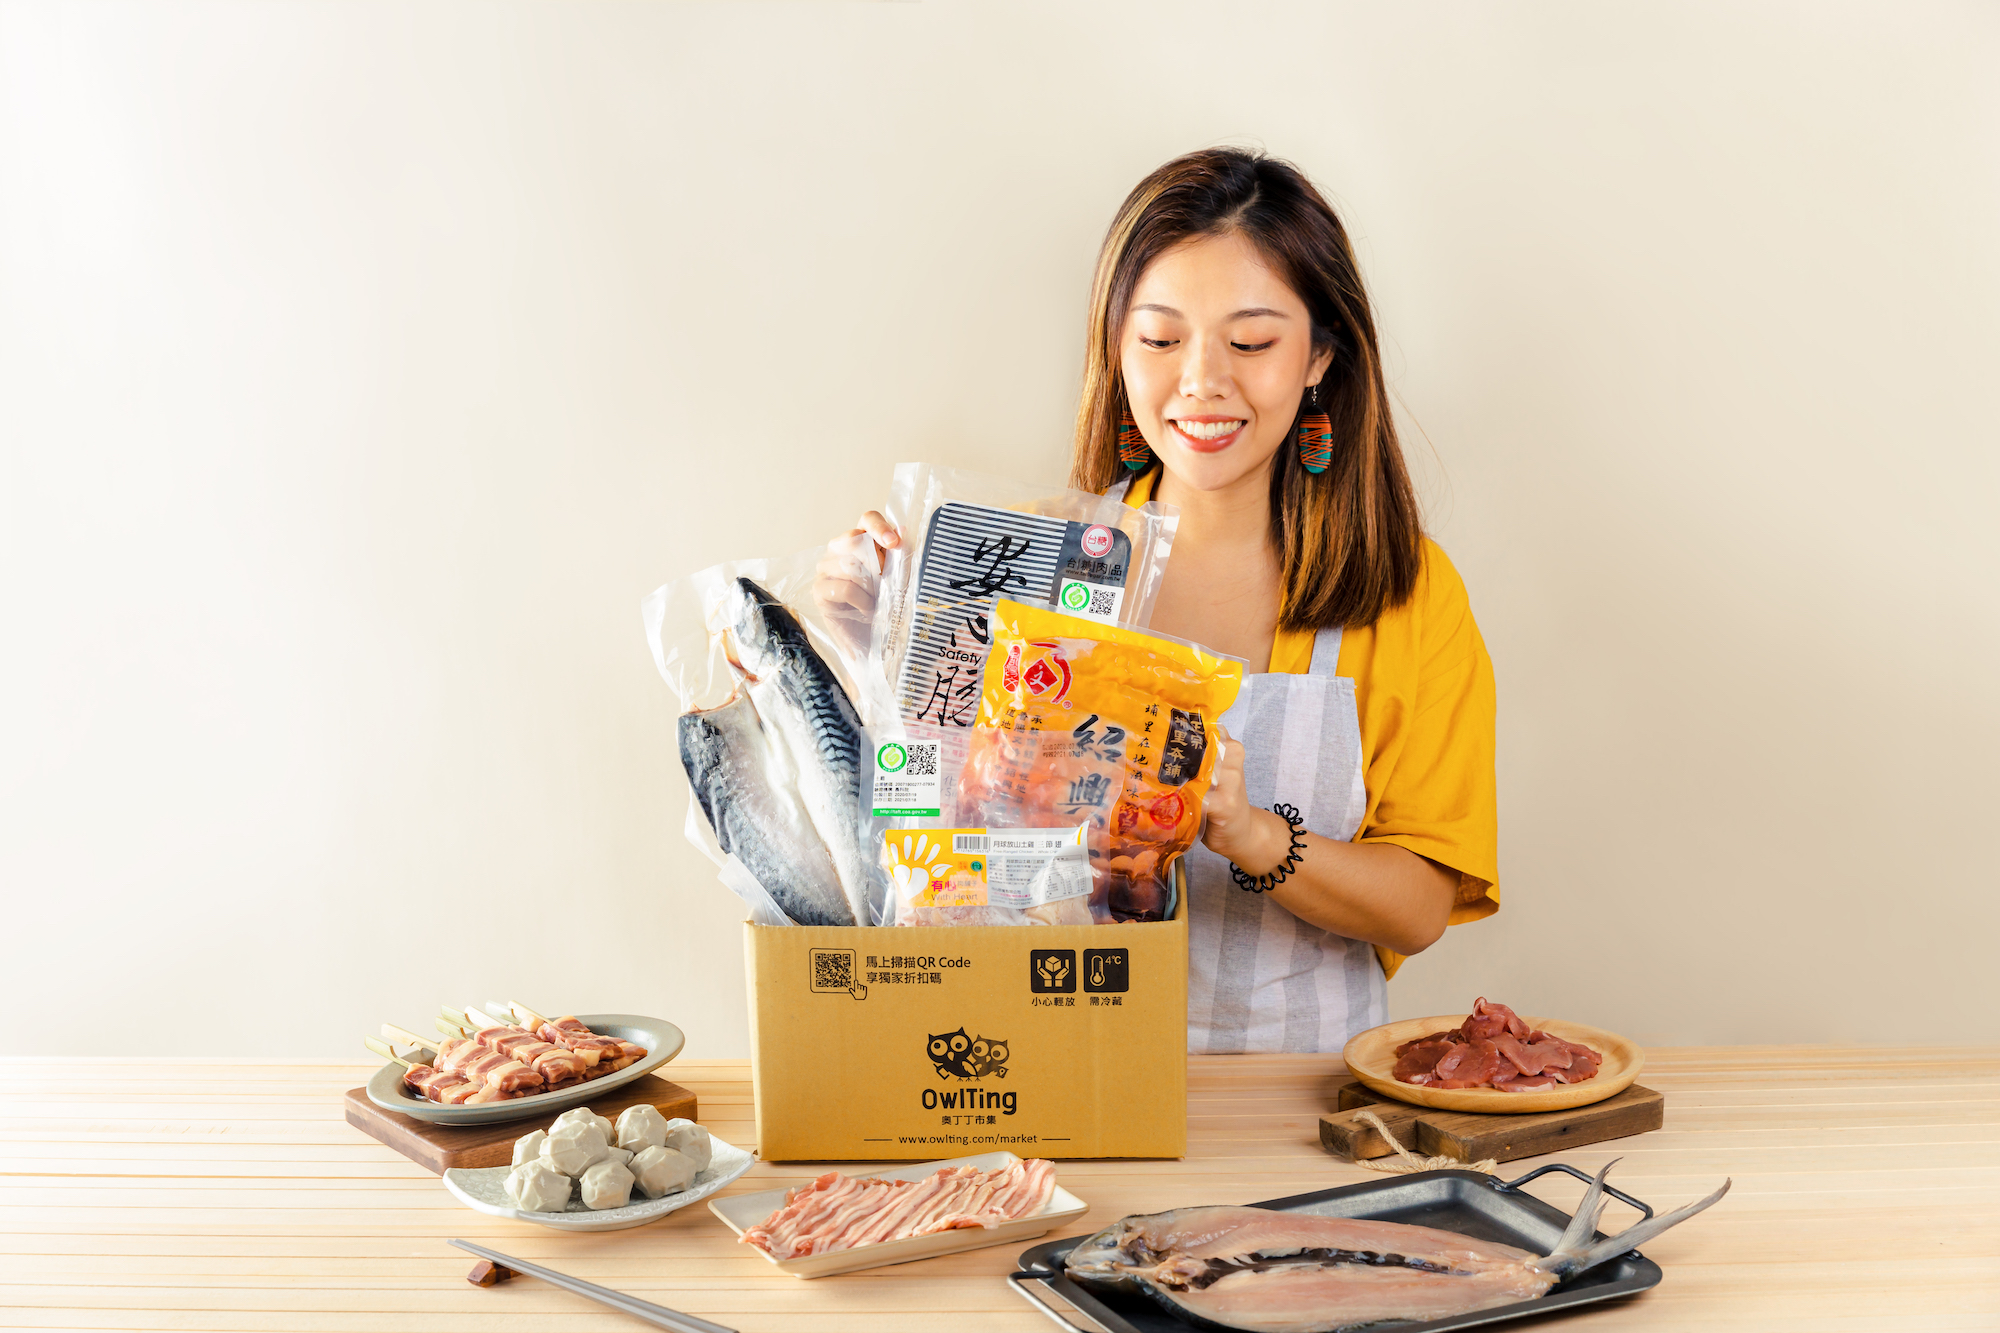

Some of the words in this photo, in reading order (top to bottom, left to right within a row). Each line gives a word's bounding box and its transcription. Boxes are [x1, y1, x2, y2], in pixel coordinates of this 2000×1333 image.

[938, 646, 982, 666] Safety
[1190, 720, 1206, 750] 正宗
[931, 880, 957, 892] 有心
[931, 893, 951, 901] With
[953, 893, 978, 901] Heart
[938, 956, 971, 968] Code
[865, 972, 942, 985] 享獨家折扣碼
[1031, 996, 1075, 1007] 小心輕放
[1089, 996, 1123, 1007] 需冷藏
[921, 1088, 1017, 1115] OwlTing
[941, 1115, 997, 1126] 奧丁丁市集
[898, 1133, 1038, 1146] www.owlting.com/market
